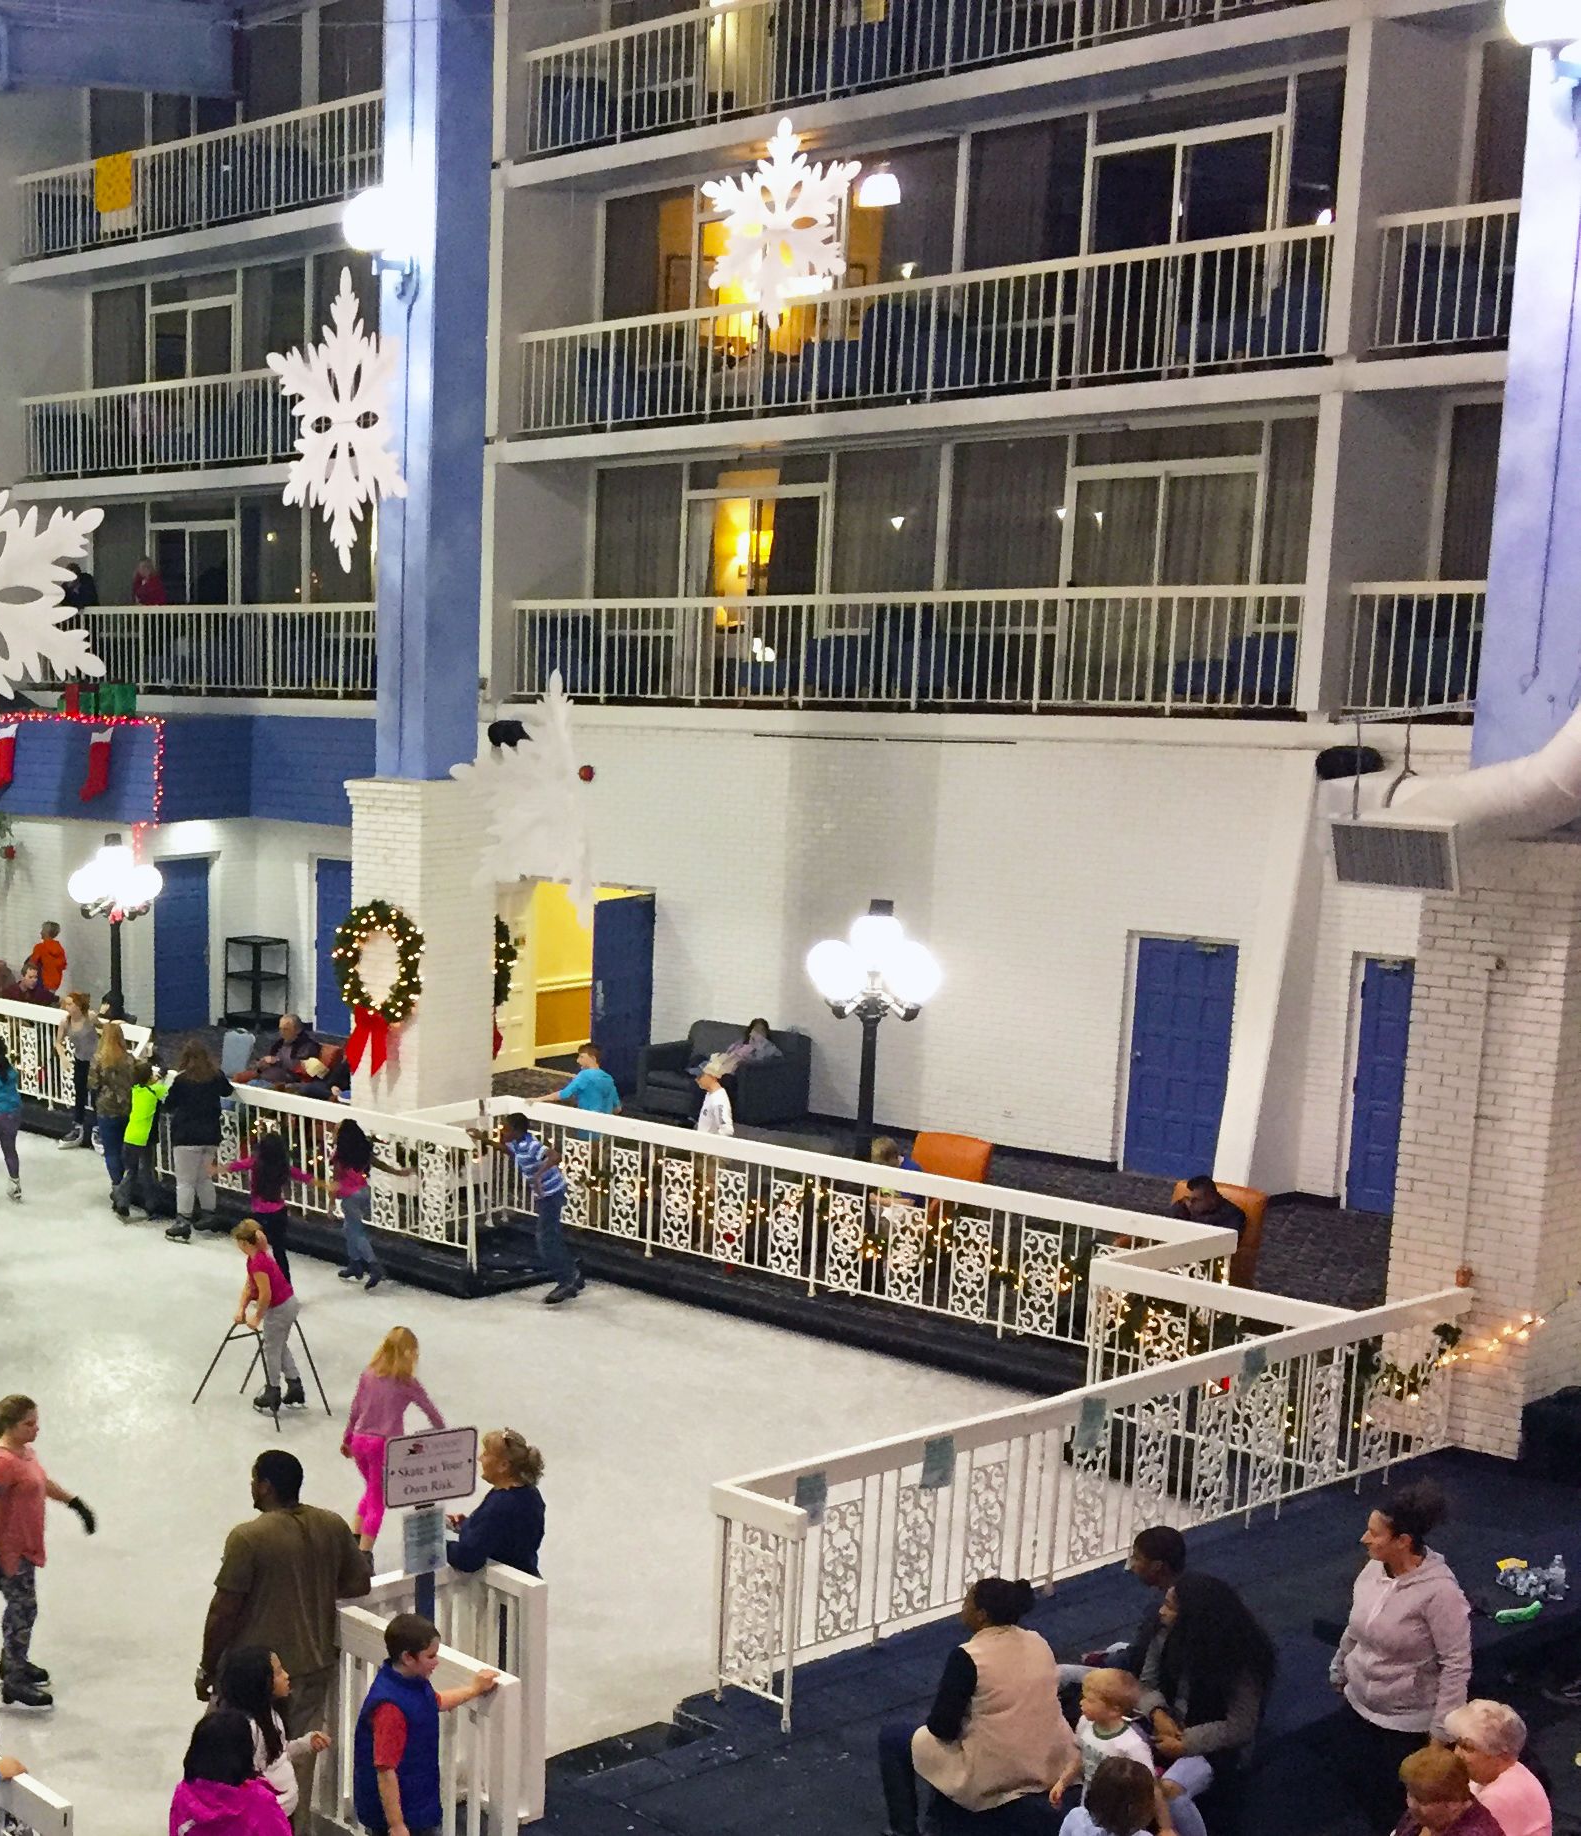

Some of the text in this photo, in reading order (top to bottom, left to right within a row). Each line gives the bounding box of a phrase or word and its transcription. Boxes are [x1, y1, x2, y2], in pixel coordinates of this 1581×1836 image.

[398, 1460, 464, 1478] Skate at Your
[404, 1484, 427, 1495] Own
